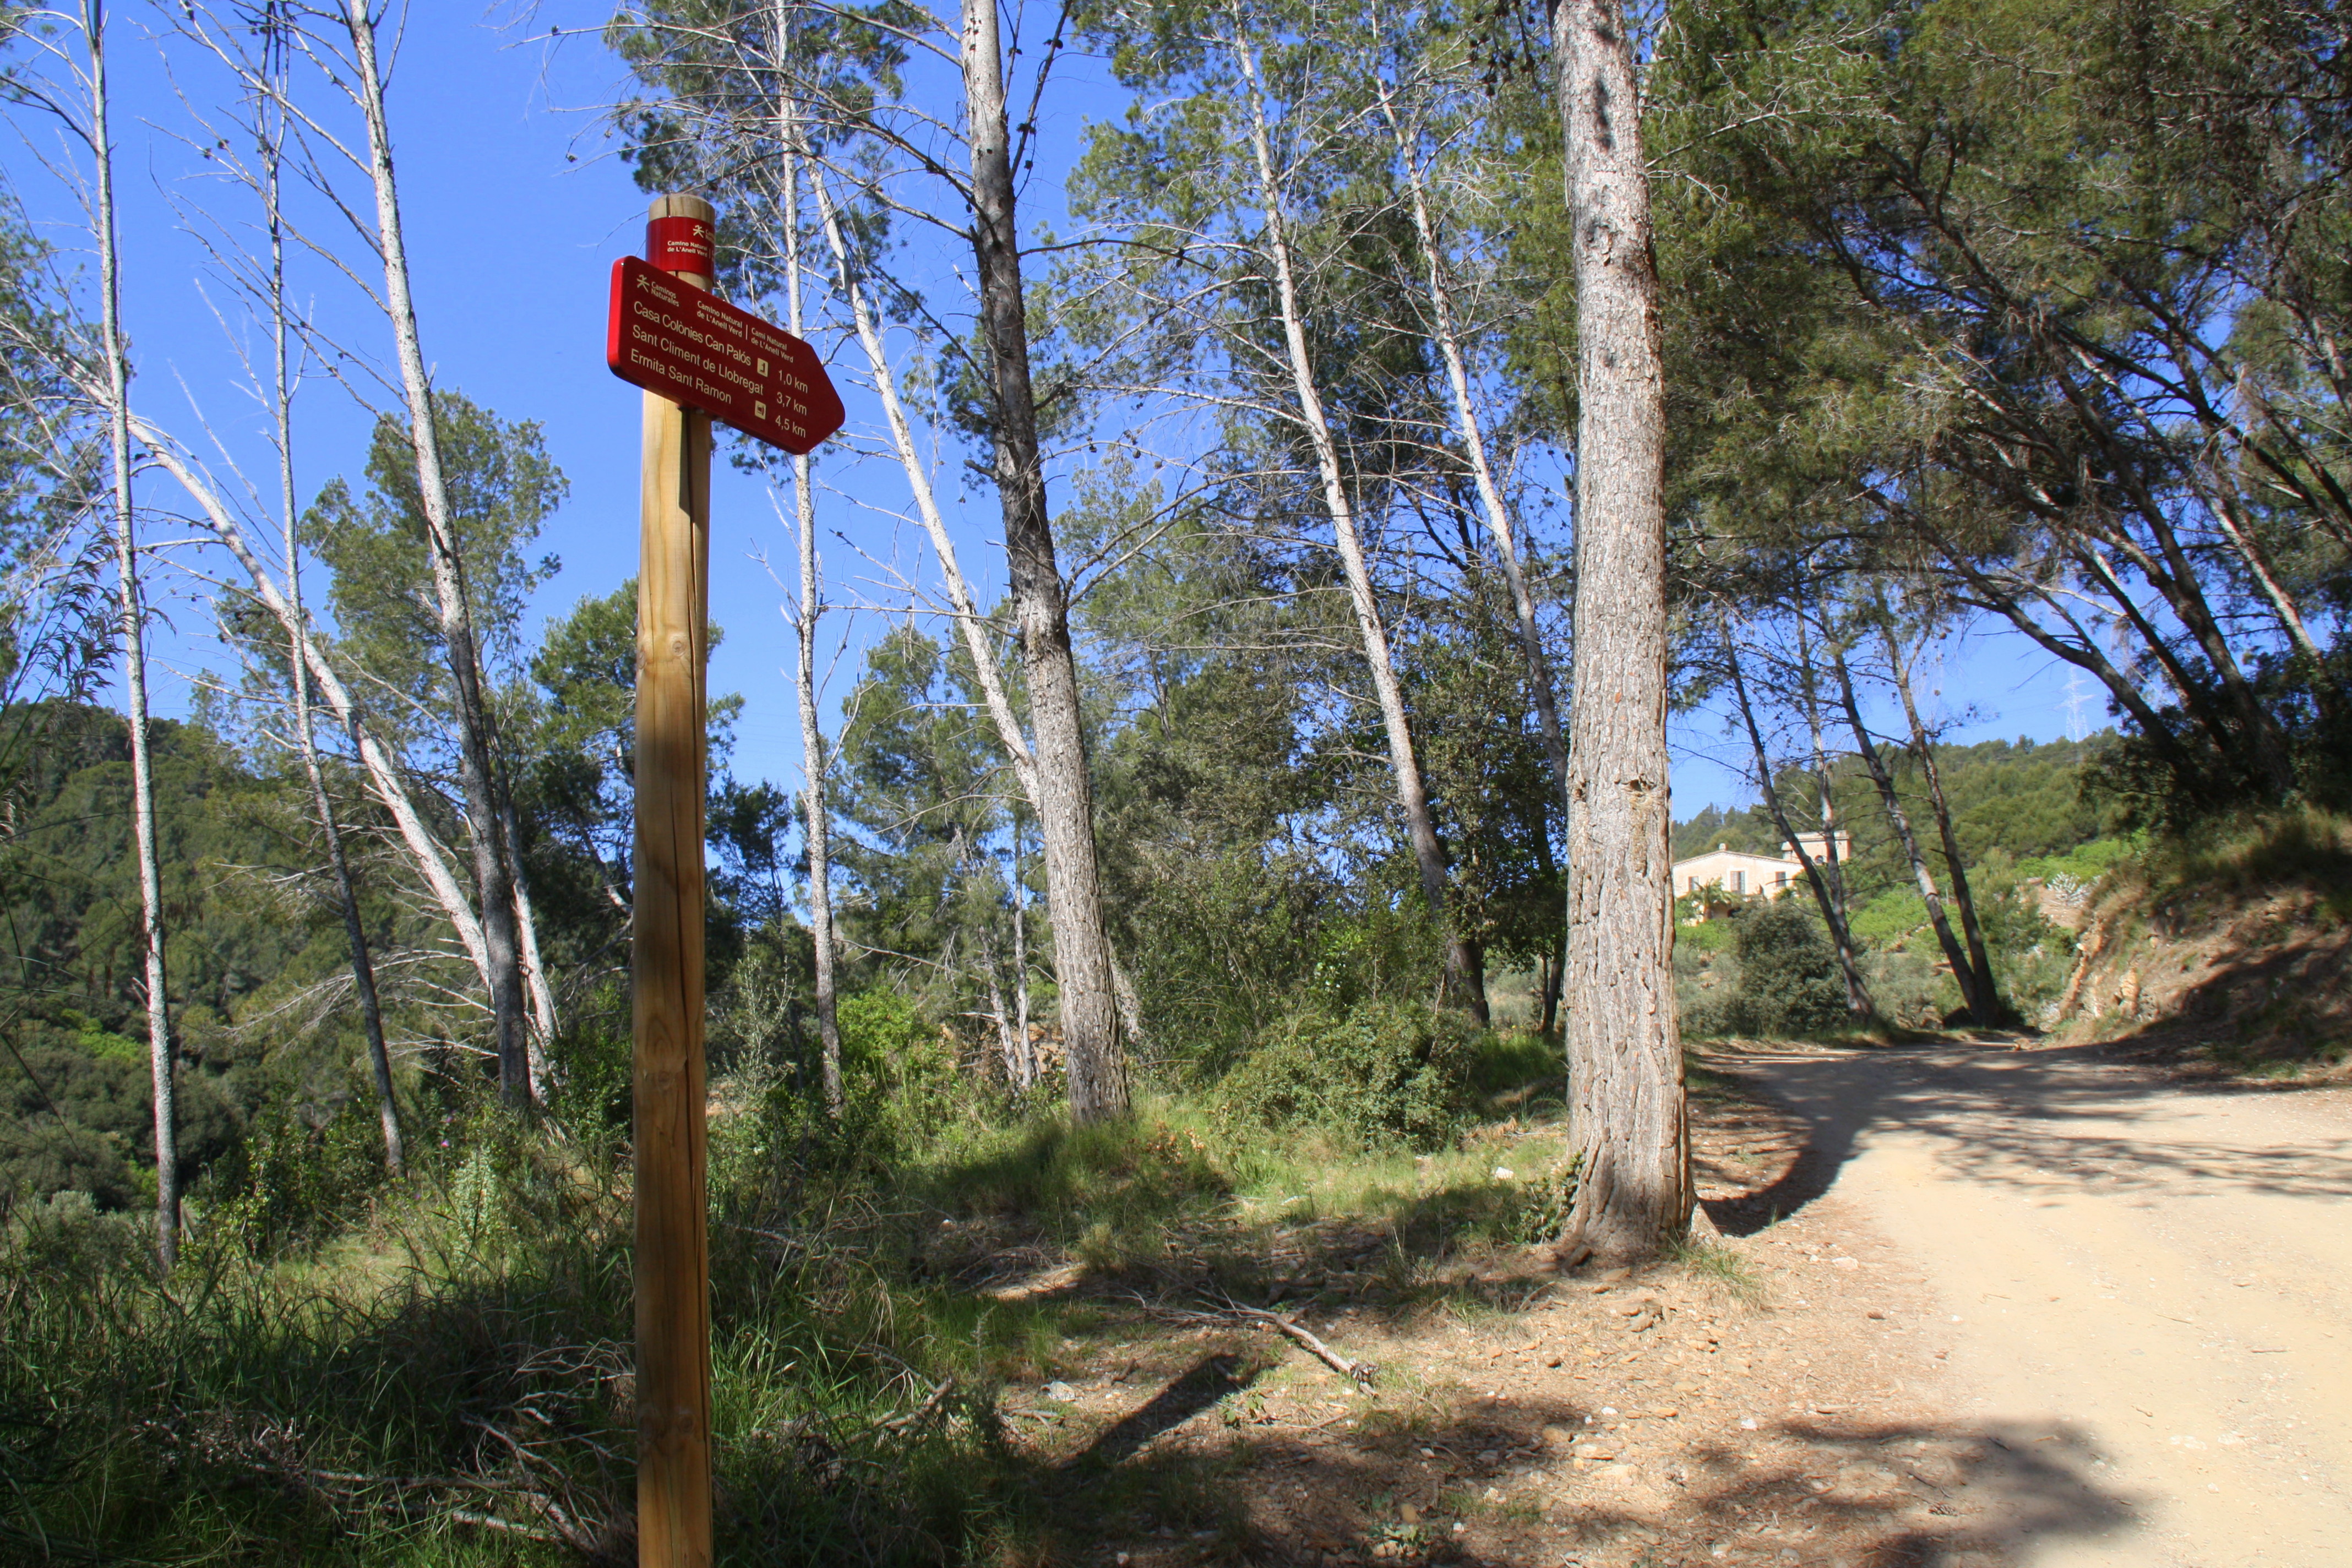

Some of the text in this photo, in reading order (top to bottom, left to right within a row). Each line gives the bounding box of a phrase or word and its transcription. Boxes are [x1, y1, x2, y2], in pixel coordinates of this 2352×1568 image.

[690, 242, 707, 251] Natural
[651, 281, 677, 299] Caminos
[651, 288, 679, 307] Naturales
[697, 301, 743, 329] Camino Natural
[697, 310, 743, 338] de L'Anell Verd
[634, 301, 751, 366] Casa Colònies Can Palós
[767, 335, 787, 351] Natural
[633, 324, 764, 395] Sant Climent de Llobregat
[751, 337, 793, 363] de L'Anell Verd
[631, 348, 732, 405] Ermita Sant Ramon
[778, 369, 808, 394] 1,0 km
[776, 391, 807, 416] 3,7 km
[775, 415, 806, 438] 4,5 km
